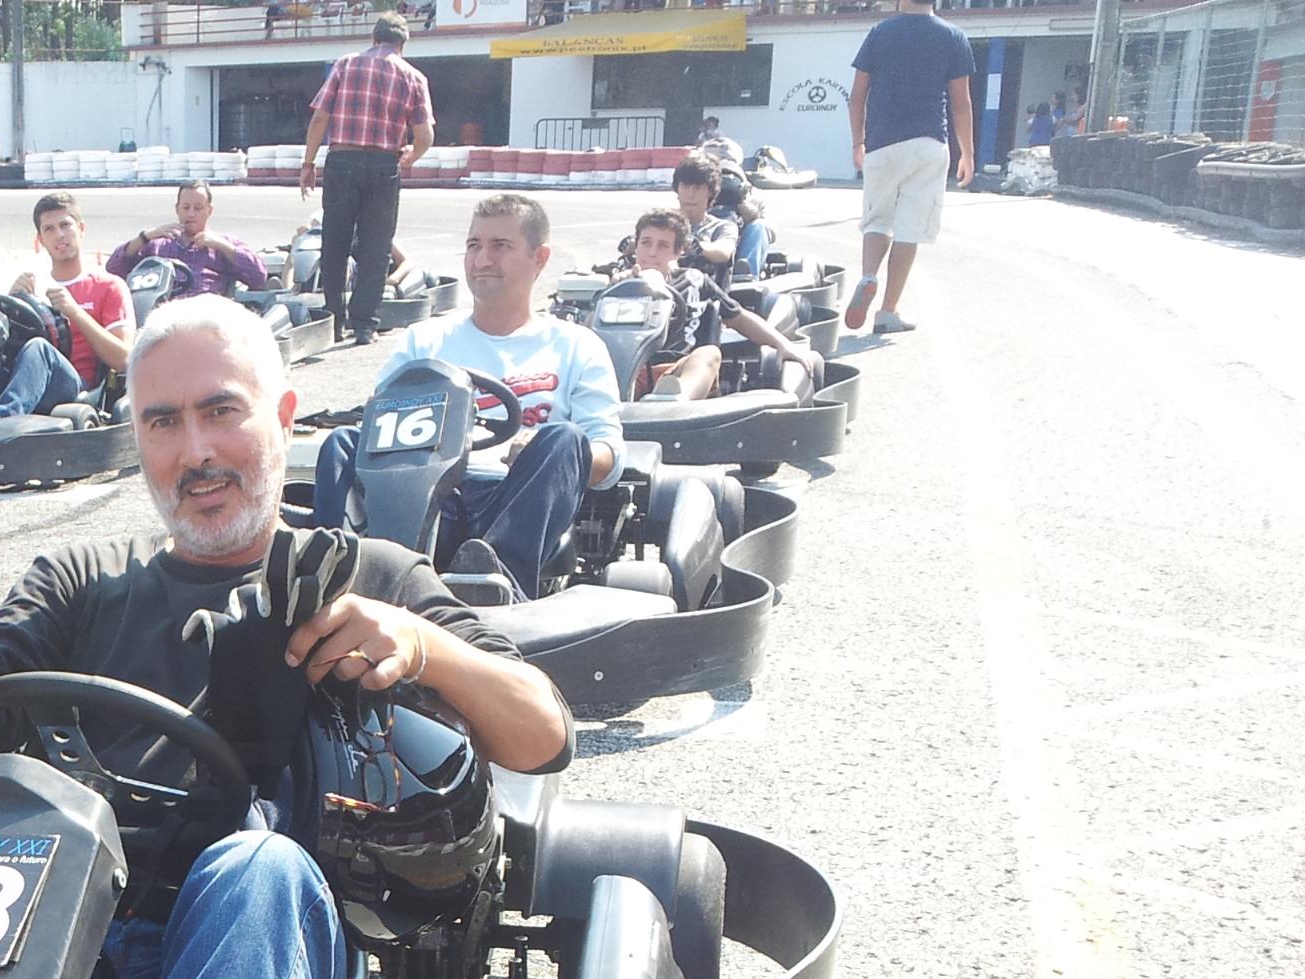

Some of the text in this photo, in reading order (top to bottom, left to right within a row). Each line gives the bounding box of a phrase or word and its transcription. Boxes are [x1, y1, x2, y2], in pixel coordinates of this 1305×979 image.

[779, 78, 850, 111] ESCOLA KARTIN
[797, 104, 838, 112] EUROINDY
[132, 272, 159, 290] 10
[603, 302, 645, 322] 12
[375, 408, 437, 449] 16
[8, 839, 52, 856] XXI
[19, 856, 48, 865] futuro
